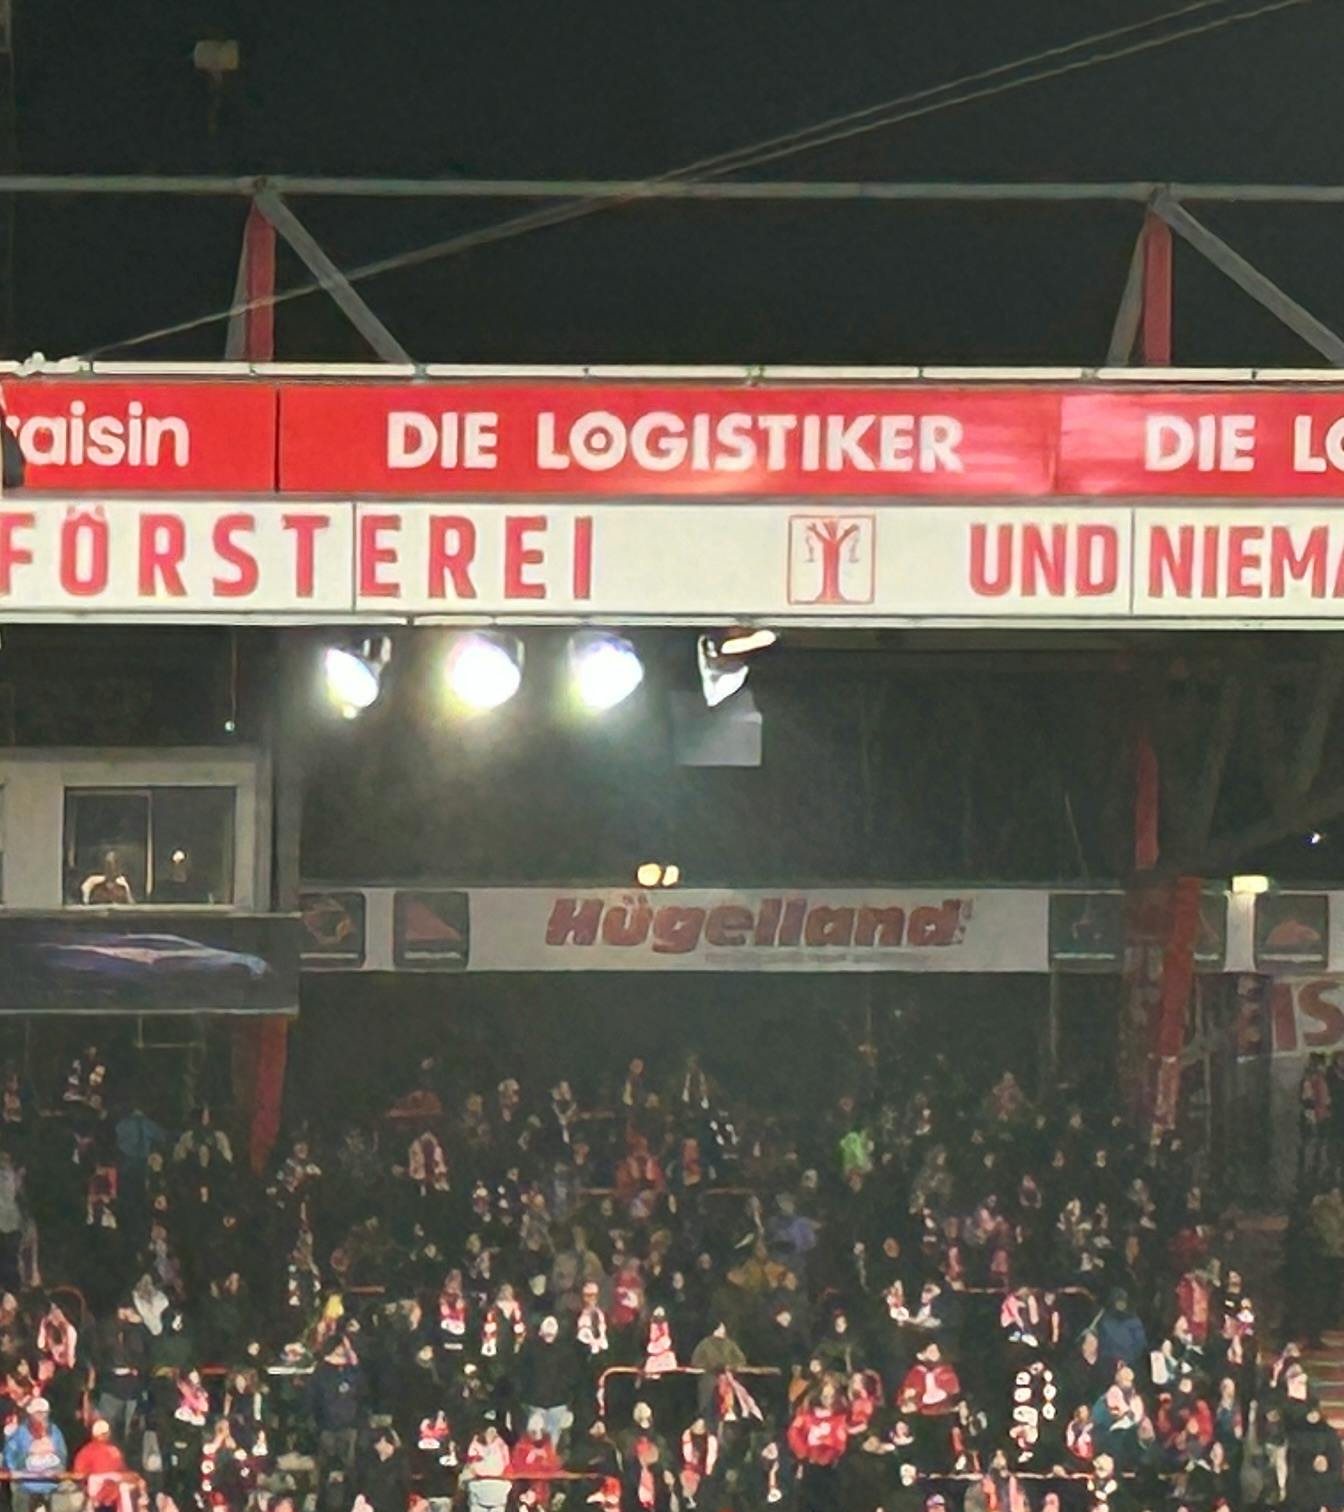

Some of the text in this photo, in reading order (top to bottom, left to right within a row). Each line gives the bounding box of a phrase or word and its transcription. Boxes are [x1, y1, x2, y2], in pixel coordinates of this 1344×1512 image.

[5, 400, 190, 467] aisin
[387, 410, 964, 473] DIE LOGISTIKER
[1144, 414, 1256, 472] DIE
[969, 522, 1344, 599] UND NIEM
[544, 893, 962, 955] Hügelland
